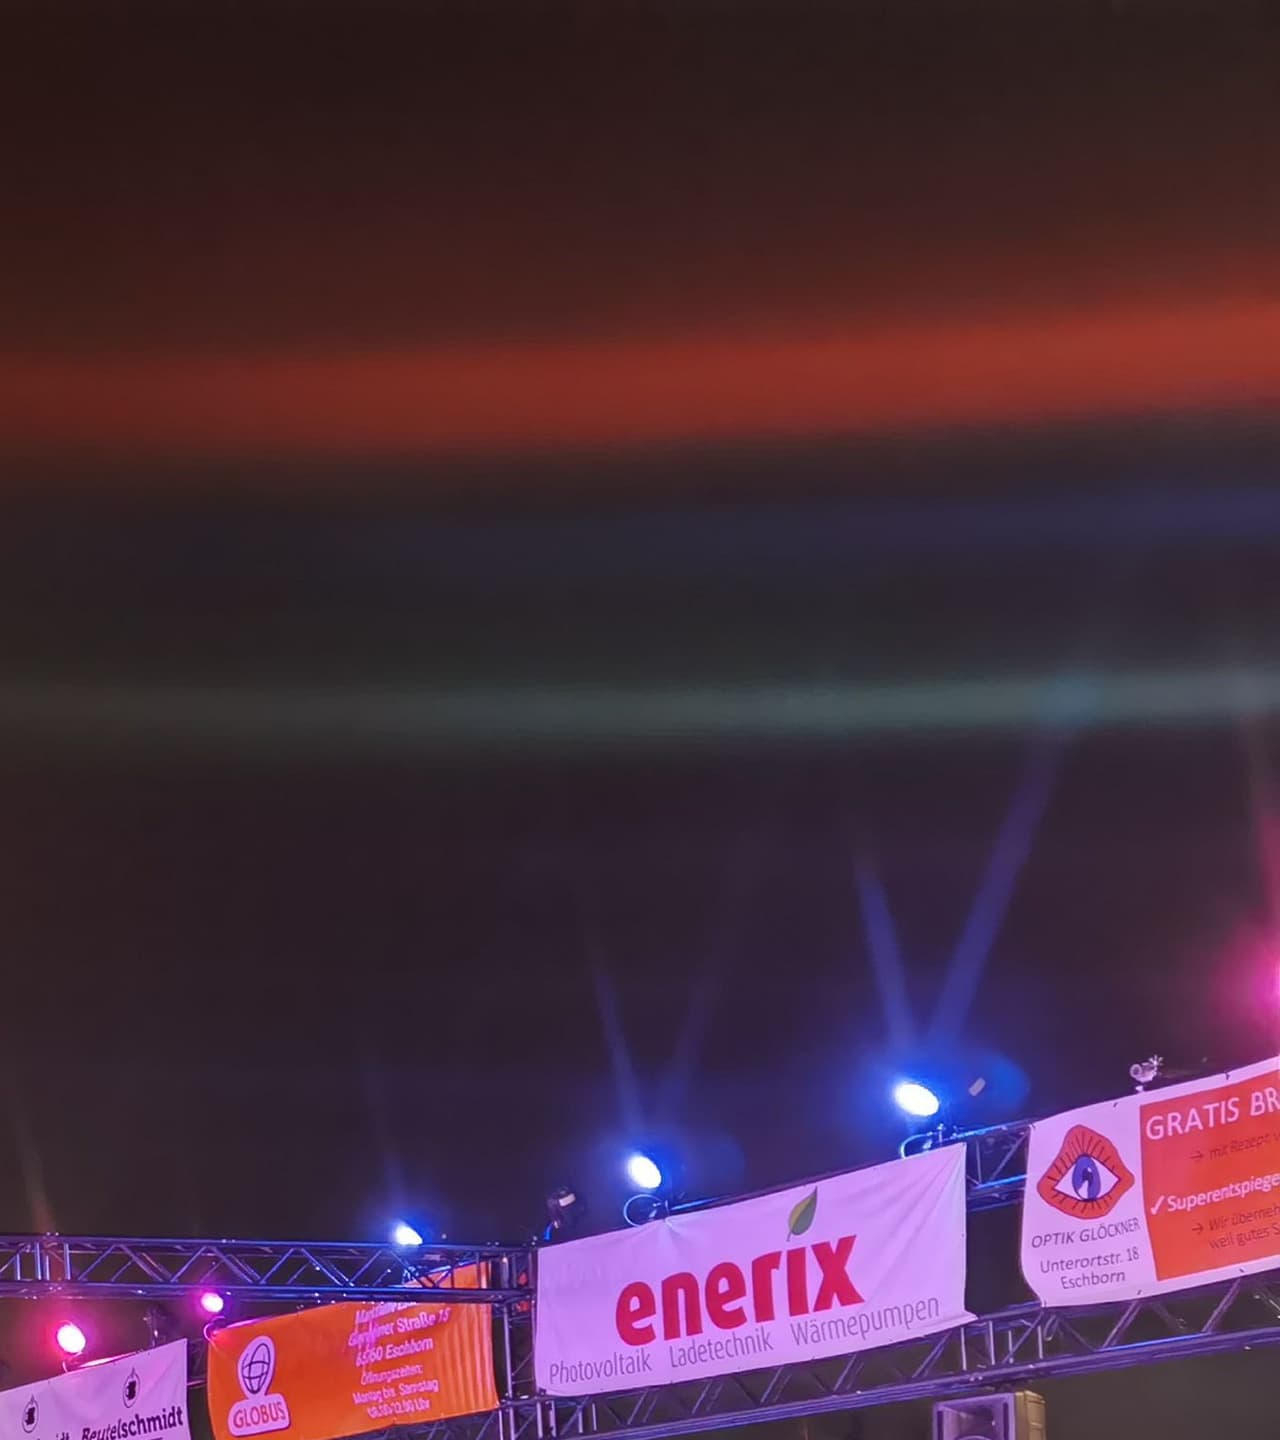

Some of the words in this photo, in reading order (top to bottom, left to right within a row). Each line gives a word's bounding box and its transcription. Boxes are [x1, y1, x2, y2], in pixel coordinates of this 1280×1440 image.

[1146, 1097, 1239, 1140] GRATIS
[1031, 1231, 1076, 1248] OPTIK
[1079, 1217, 1140, 1242] GLÖCKNER
[1040, 1253, 1122, 1274] Unterortstr.
[1126, 1246, 1140, 1262] 18
[615, 1234, 864, 1347] enerix
[1060, 1271, 1126, 1290] Eschborn
[397, 1312, 436, 1333] Straße
[386, 1338, 433, 1359] Eschborn
[549, 1347, 653, 1386] Photovoltaik
[669, 1328, 774, 1369] Ladetechnik
[790, 1297, 939, 1347] Wärmepumpen
[233, 1401, 286, 1429] GLOBUS
